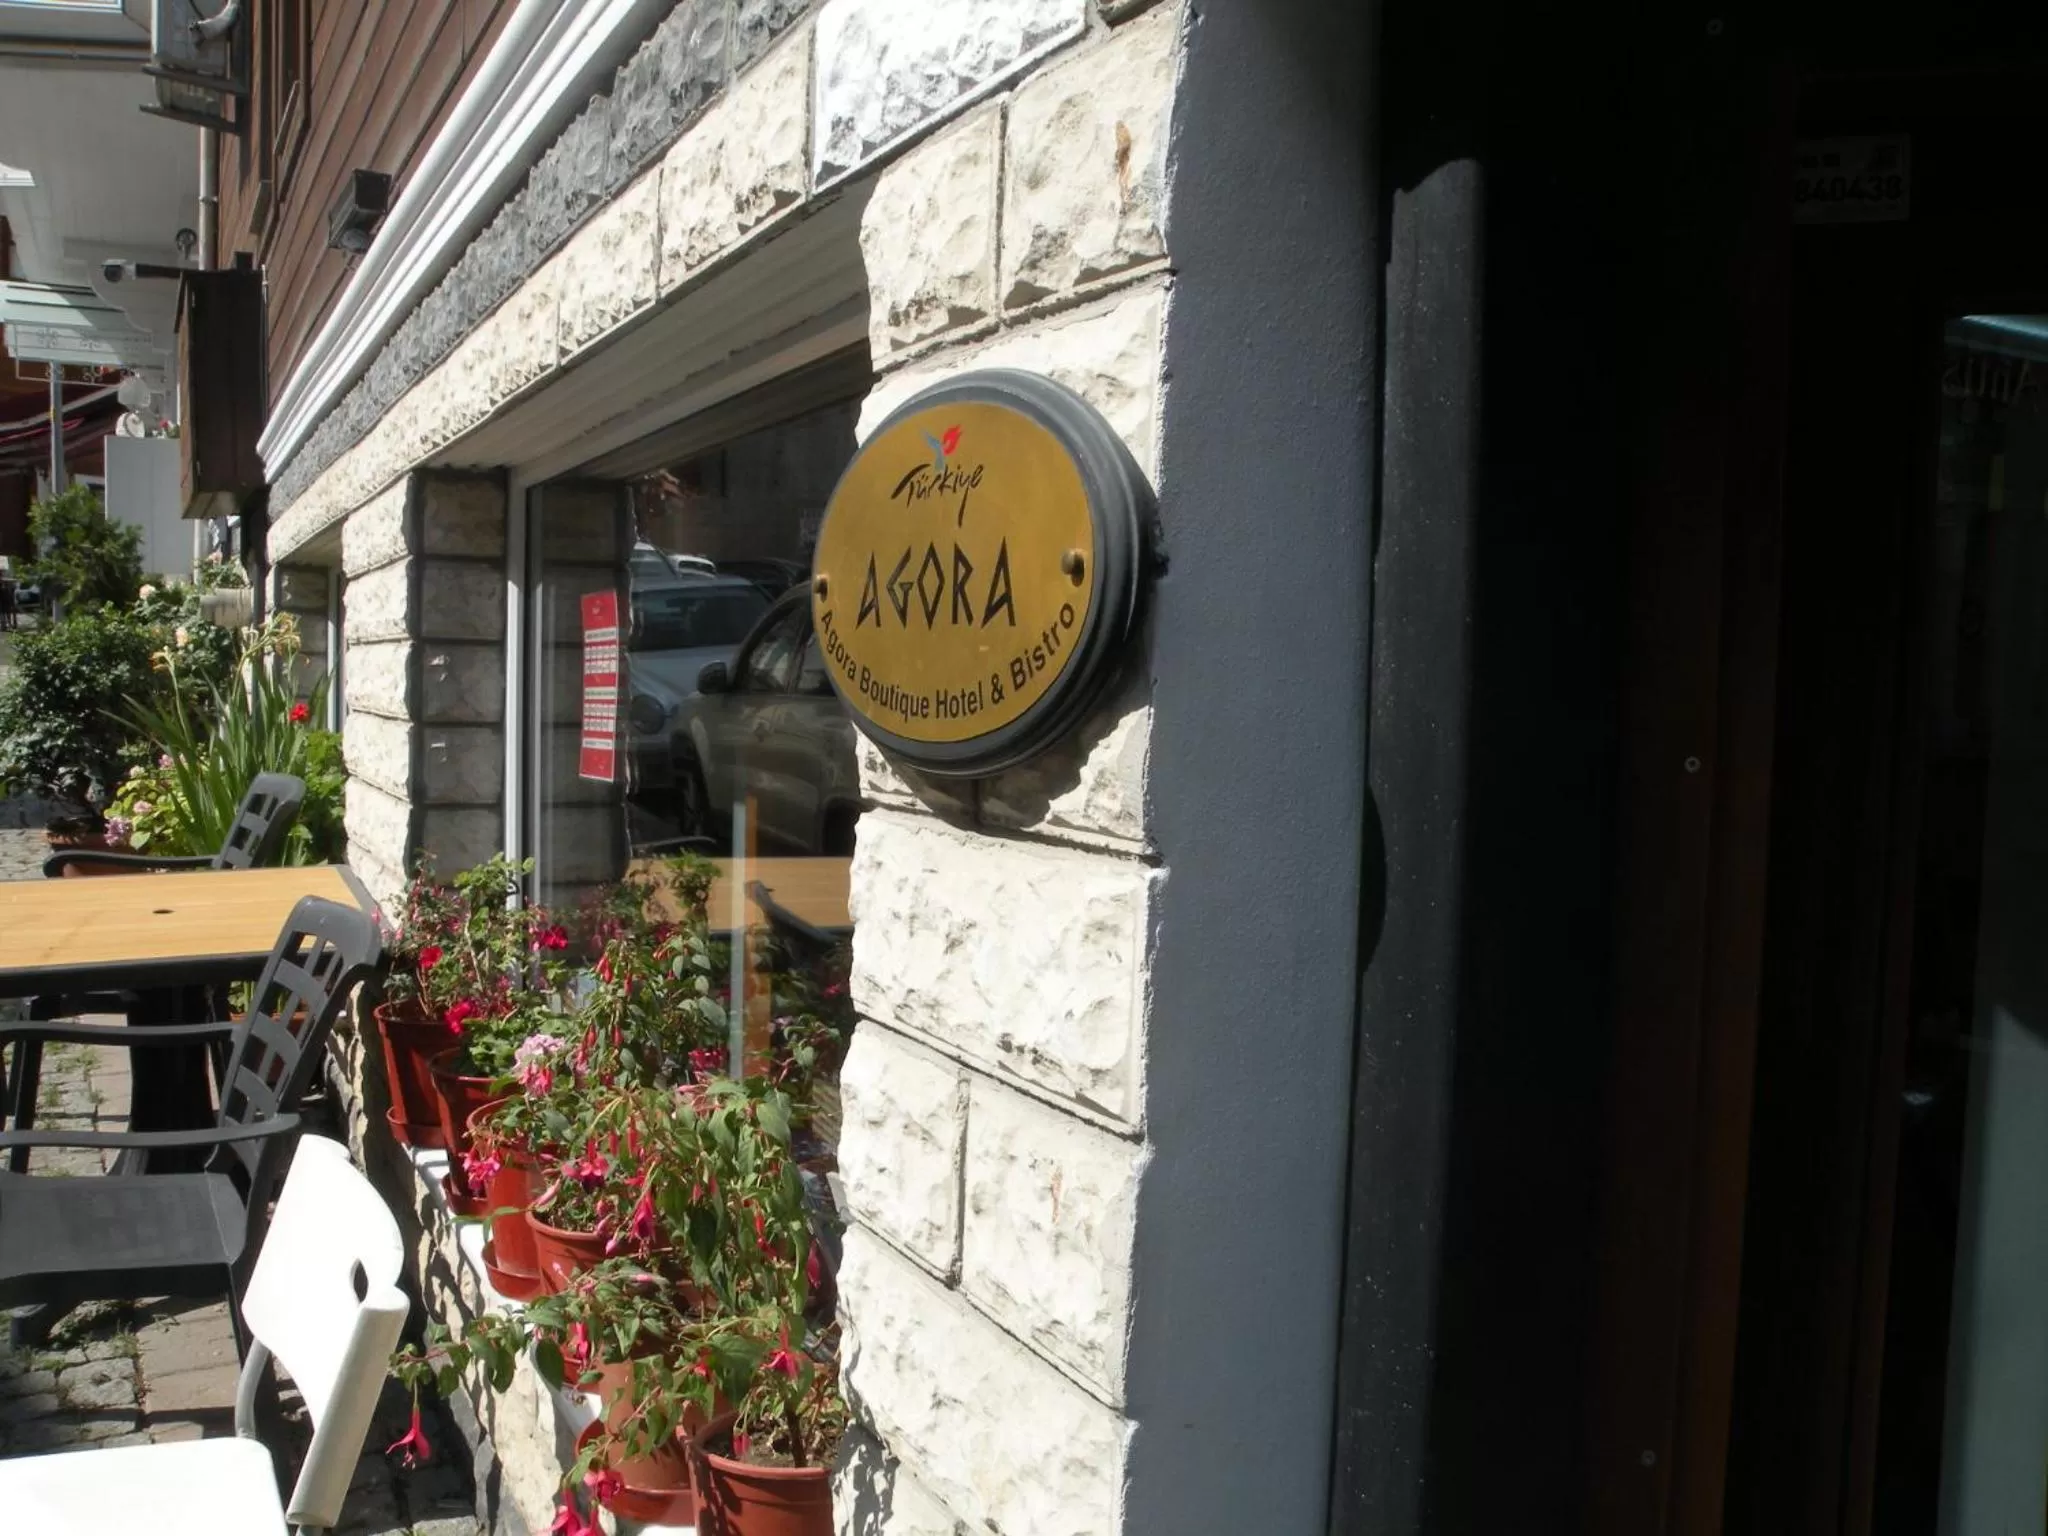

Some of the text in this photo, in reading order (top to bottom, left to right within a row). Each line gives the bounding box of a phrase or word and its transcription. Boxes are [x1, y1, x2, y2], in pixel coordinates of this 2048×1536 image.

[891, 464, 984, 528] Türkiye
[856, 536, 1016, 630] AGORA
[821, 600, 1076, 723] Agora Boutique Hotel & Bistro
